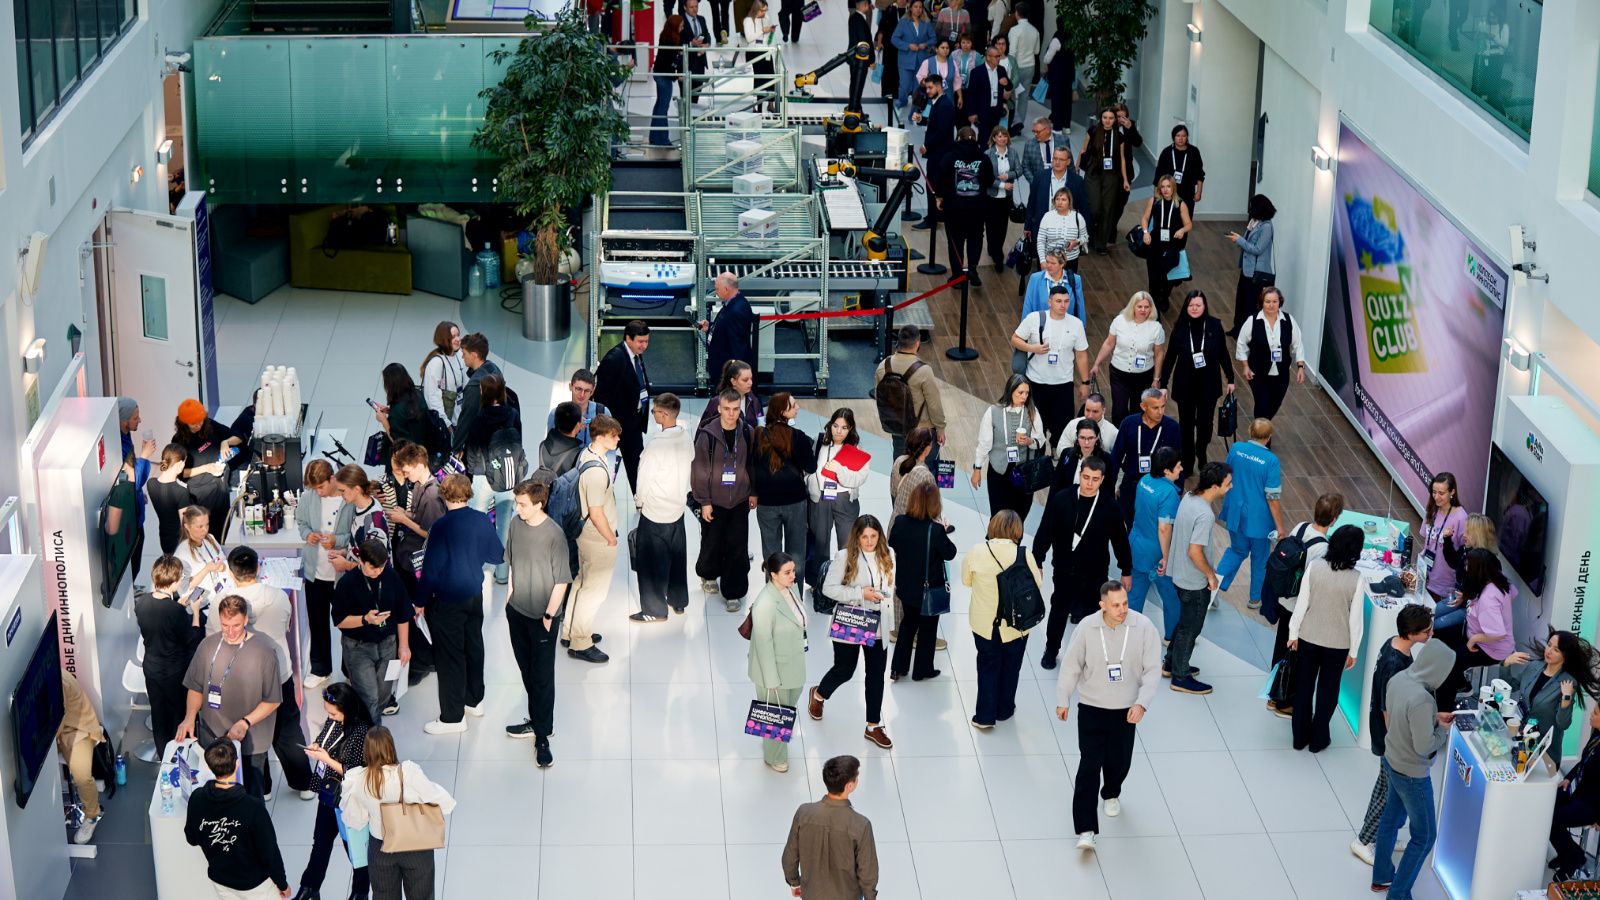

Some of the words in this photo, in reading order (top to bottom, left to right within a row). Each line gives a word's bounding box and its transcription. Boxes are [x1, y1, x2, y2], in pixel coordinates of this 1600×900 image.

[1366, 295, 1411, 321] QUIZ
[1373, 322, 1418, 357] CLUB
[1386, 423, 1410, 459] knowledge
[1410, 455, 1420, 472] and
[53, 530, 69, 615] ИННОПОЛИСА
[1578, 550, 1591, 583] ДЕНЬ
[61, 618, 76, 645] ДНИ
